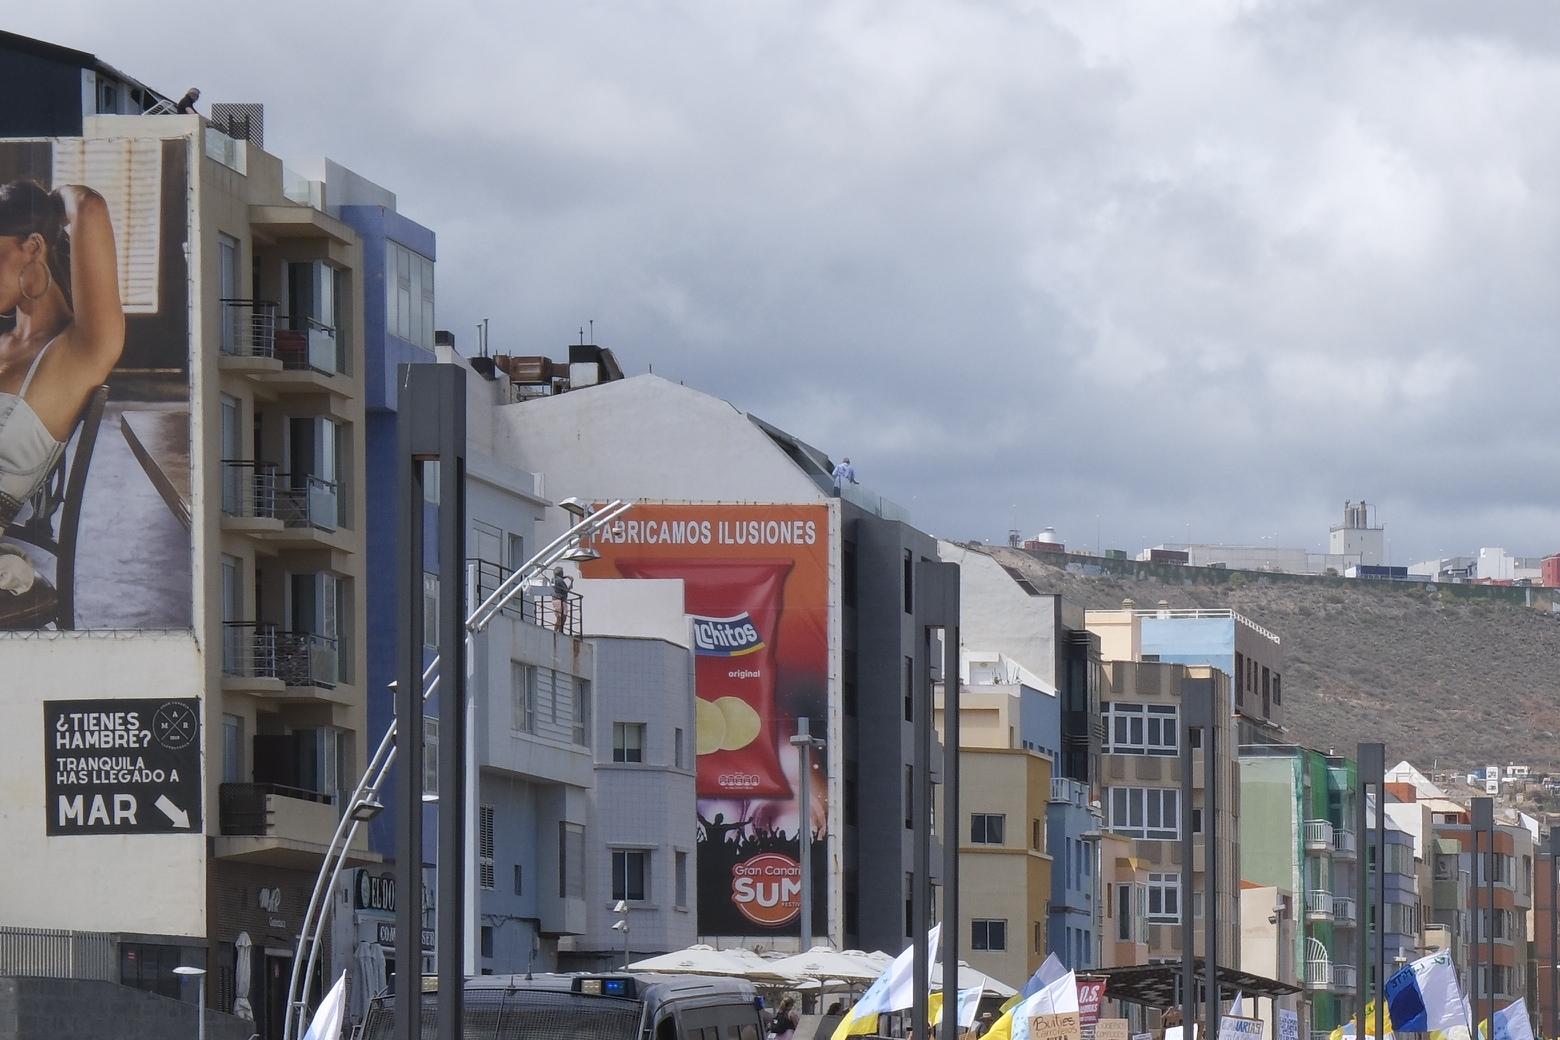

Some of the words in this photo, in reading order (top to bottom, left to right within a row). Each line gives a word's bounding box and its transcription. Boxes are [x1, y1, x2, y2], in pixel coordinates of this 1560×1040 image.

[591, 520, 711, 544] FABRICAMOS
[718, 520, 816, 545] ILUSIONES
[728, 669, 761, 680] original
[56, 712, 140, 731] ¿TIENES
[56, 730, 152, 749] HAMBRE?
[57, 756, 145, 771] TRANQUILA
[57, 770, 88, 785] HAS
[93, 769, 165, 784] LLEGADO
[169, 769, 179, 783] A
[58, 794, 137, 826] MAR
[735, 865, 762, 876] Gran
[765, 865, 801, 876] Canari
